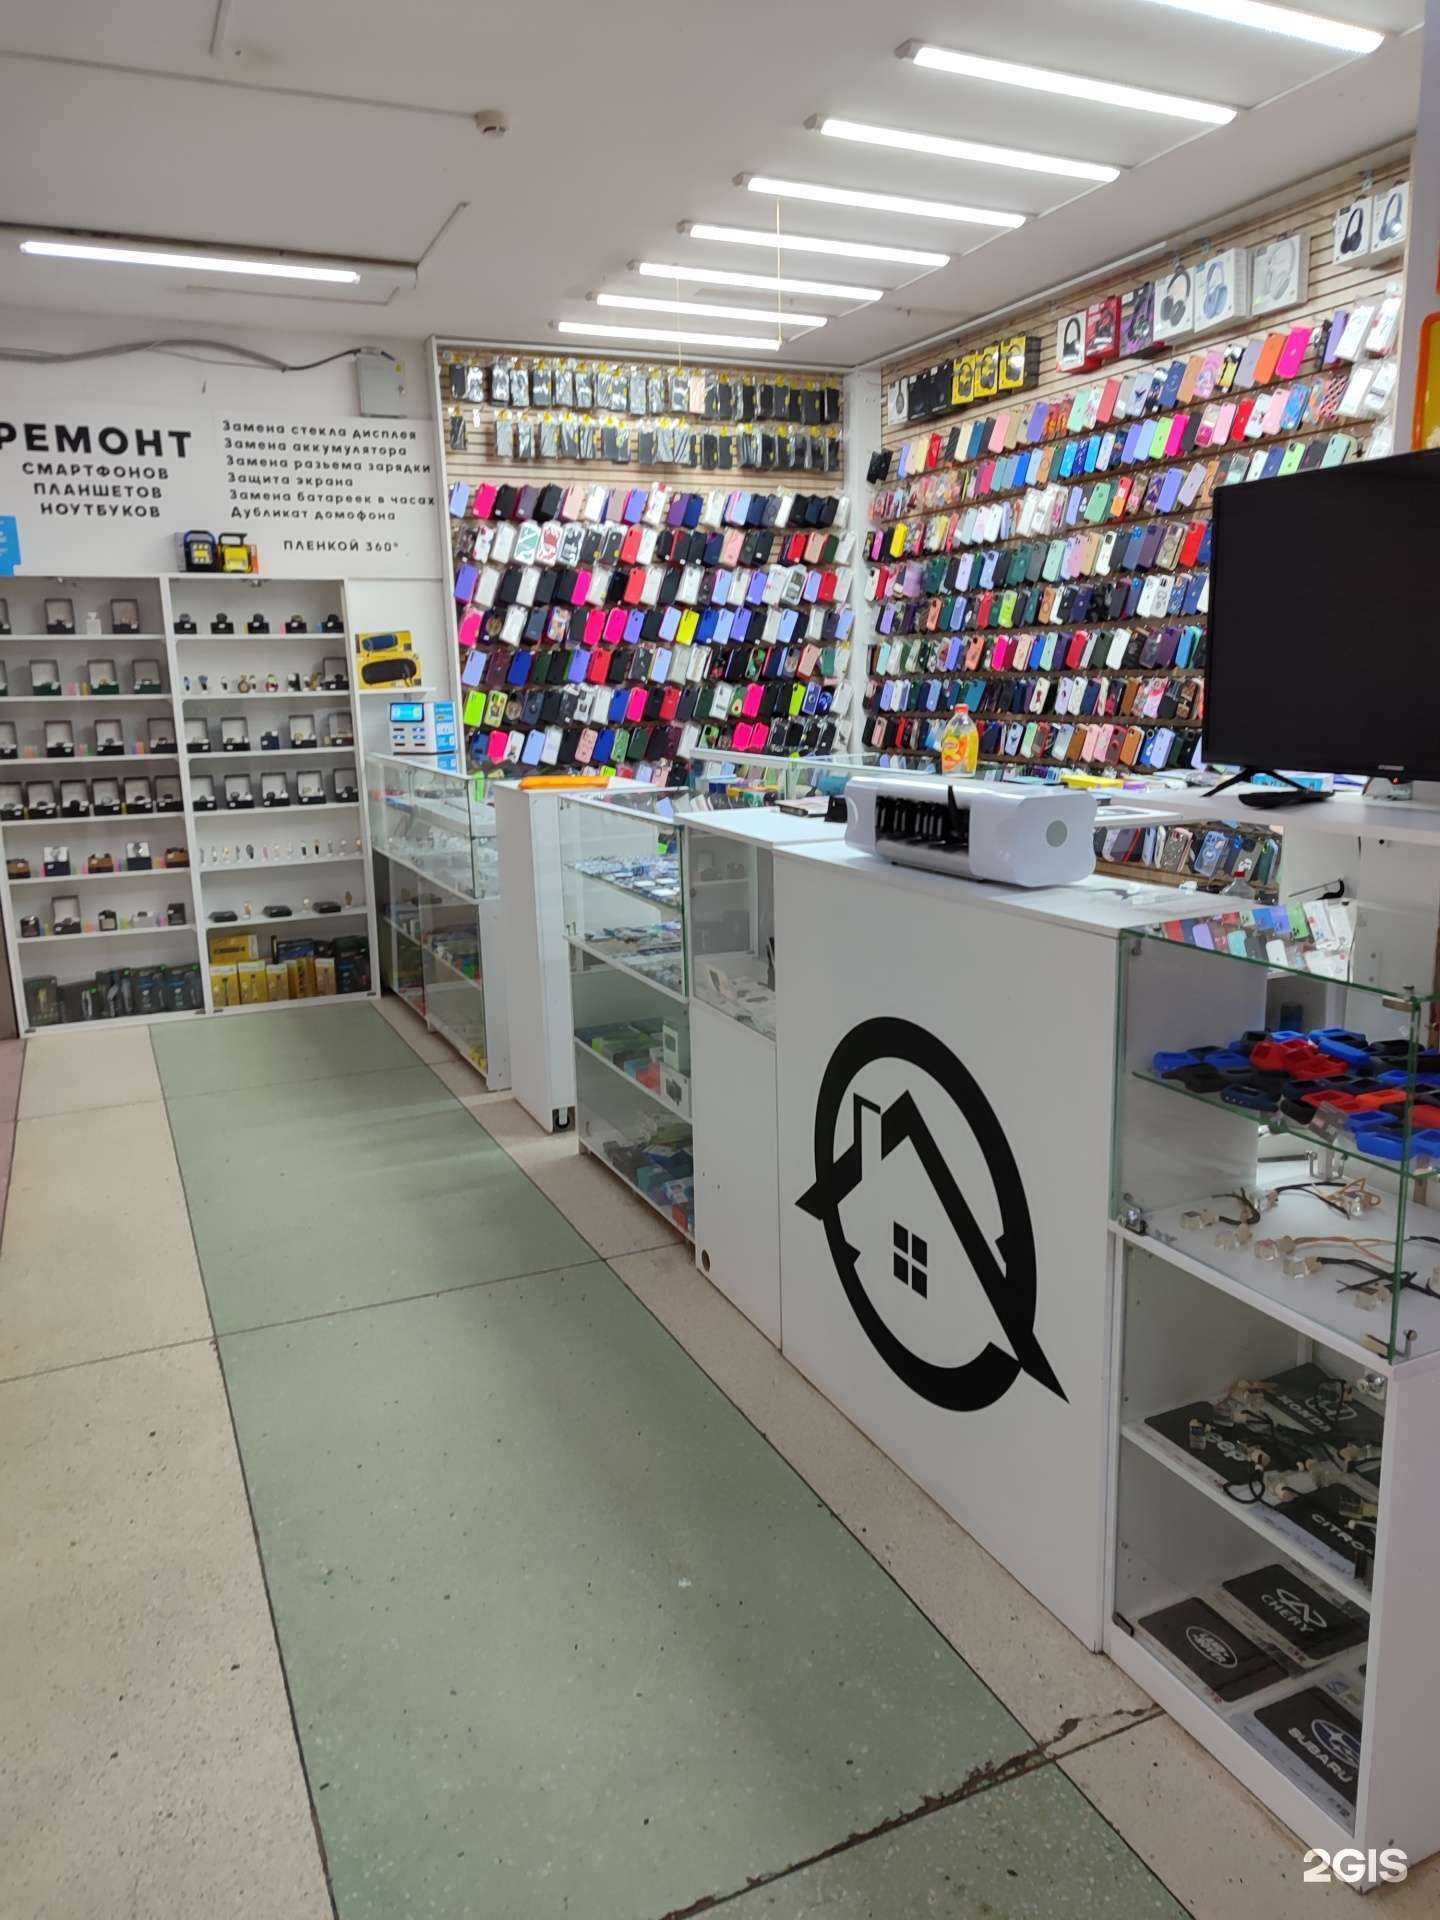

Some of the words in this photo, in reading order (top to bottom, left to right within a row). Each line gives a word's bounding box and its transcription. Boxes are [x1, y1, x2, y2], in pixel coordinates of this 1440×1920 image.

[222, 420, 285, 434] Замена
[291, 427, 347, 437] стекла
[352, 429, 416, 441] дисплея
[0, 422, 191, 458] РЕМОНТ
[224, 437, 287, 451] Замена
[293, 442, 407, 457] аккумулятора
[22, 462, 169, 480] СМАРТФОНОВ
[226, 455, 288, 468] Замена
[368, 463, 431, 475] зарядки
[227, 472, 290, 486] Защита
[296, 476, 354, 488] экрана
[34, 482, 163, 499] ПЛАНШЕТОВ
[229, 489, 291, 502] Замена
[297, 492, 372, 505] батареек
[391, 496, 435, 506] часах
[41, 502, 161, 518] НОУТБУКОВ
[231, 506, 309, 519] Дубликат
[314, 511, 396, 522] домофона
[283, 538, 360, 552] ПЛЕНКОЙ
[1261, 1594, 1314, 1632] CHERY
[1288, 1727, 1354, 1783] SUBARU
